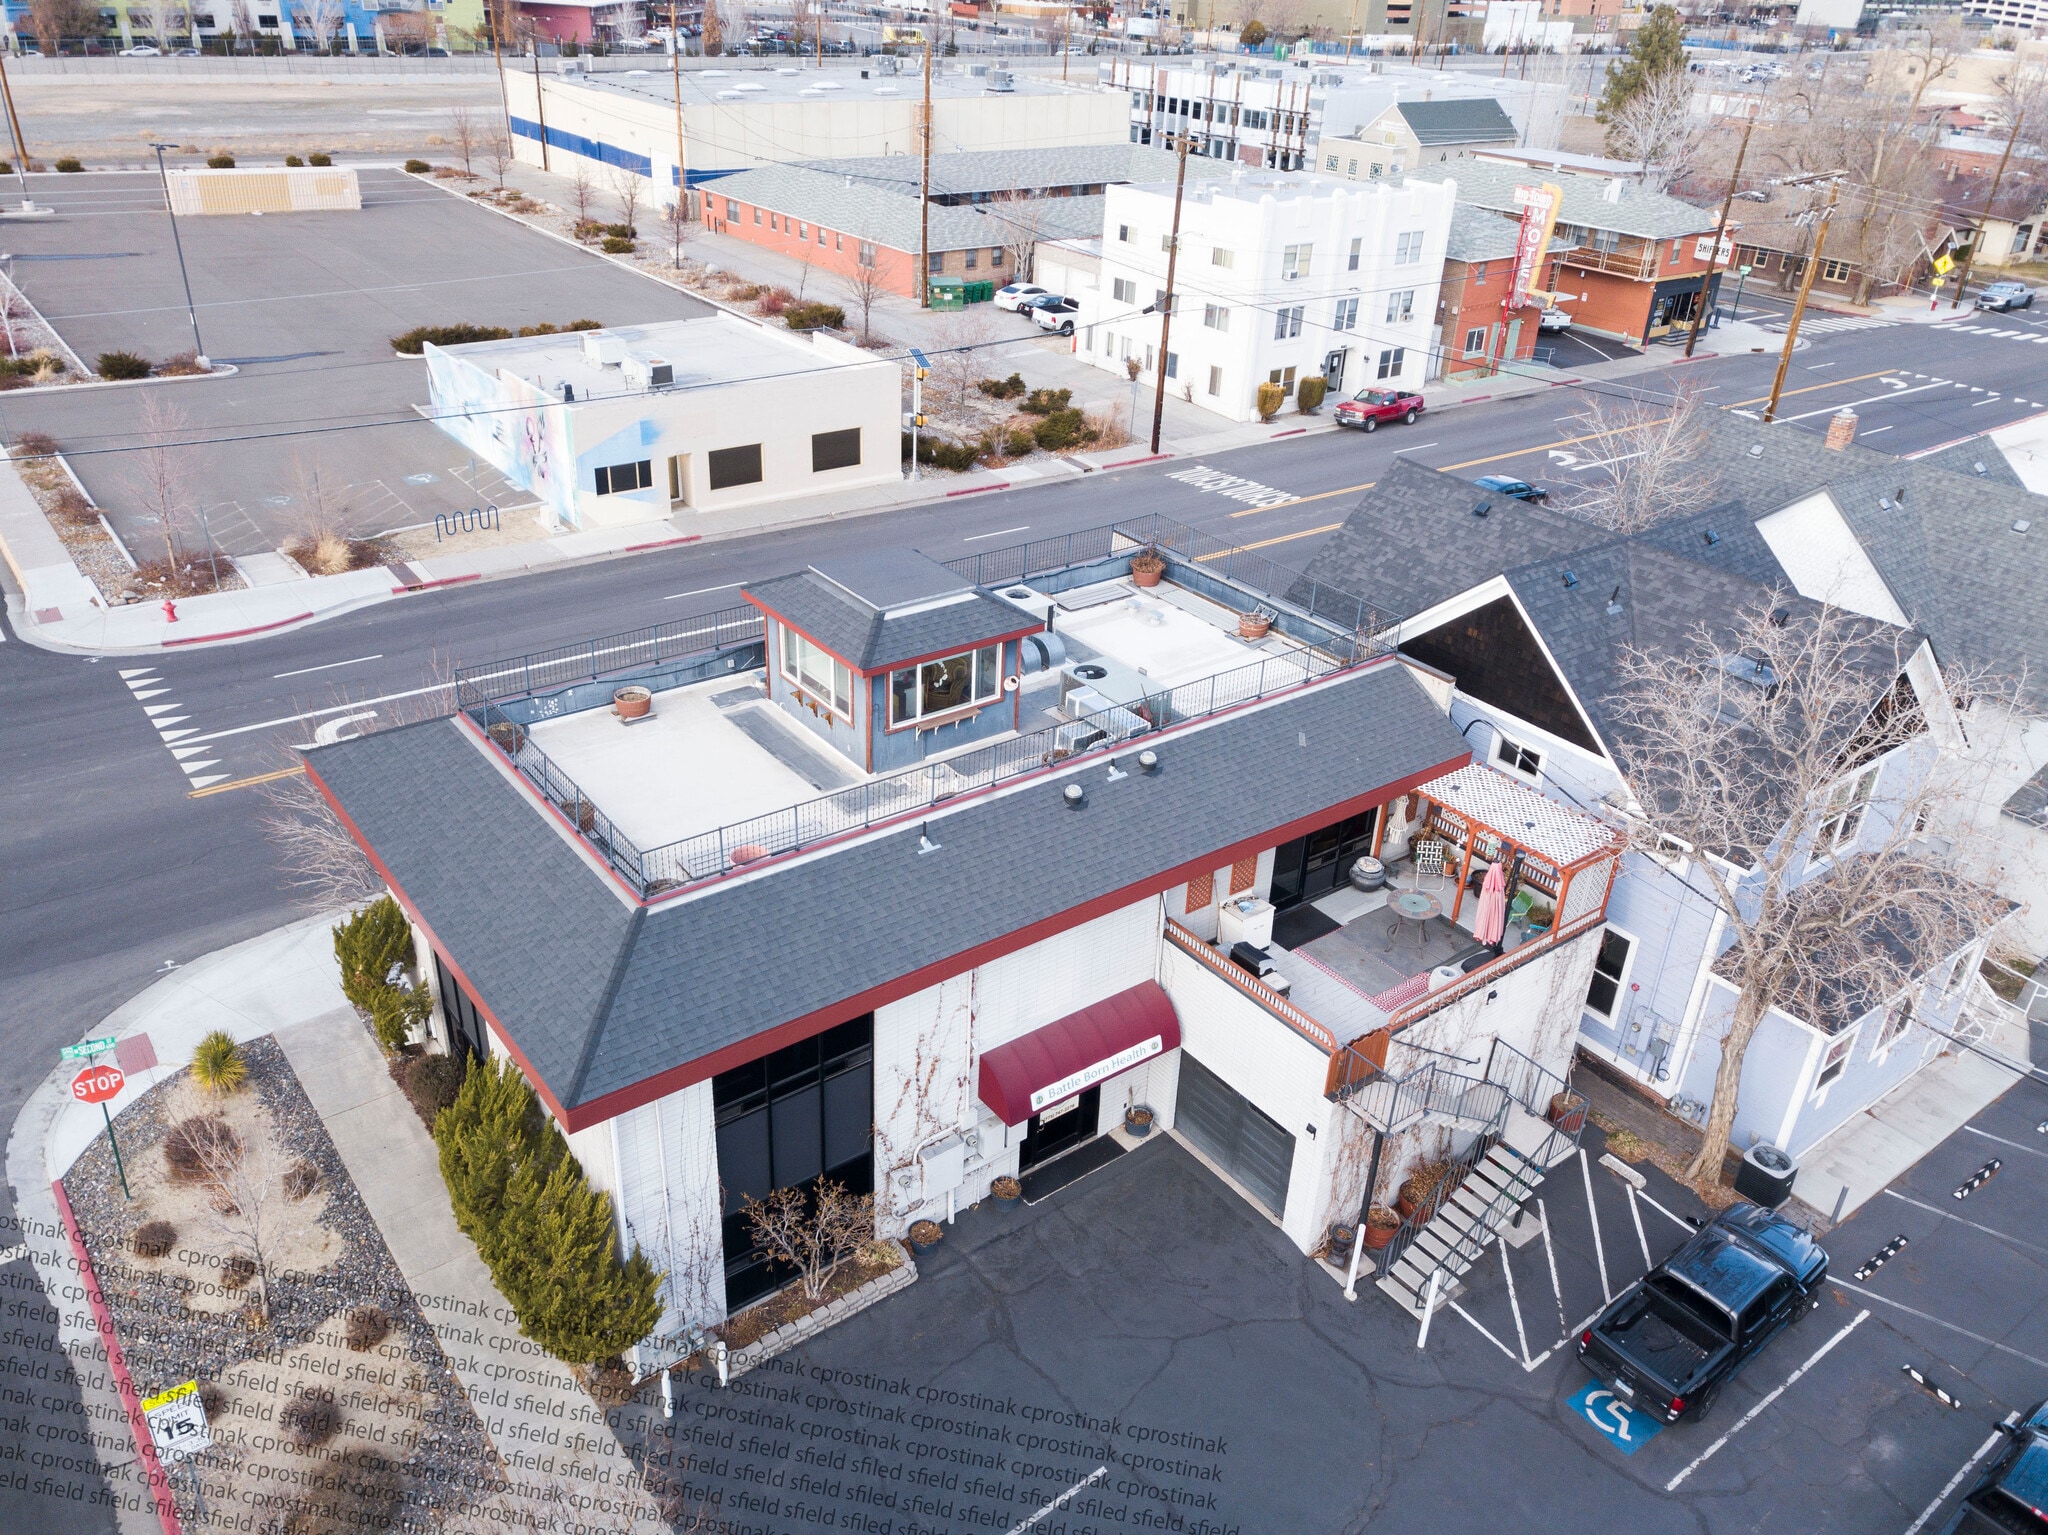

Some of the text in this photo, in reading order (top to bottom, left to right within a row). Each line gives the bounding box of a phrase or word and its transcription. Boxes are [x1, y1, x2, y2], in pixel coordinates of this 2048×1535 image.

[1517, 207, 1547, 293] MOTEL
[1698, 243, 1731, 257] SHIFERS
[78, 1041, 106, 1056] SECOND
[74, 1072, 122, 1097] STOP
[1048, 1047, 1146, 1098] Battle Born Health
[163, 1417, 195, 1440] 15
